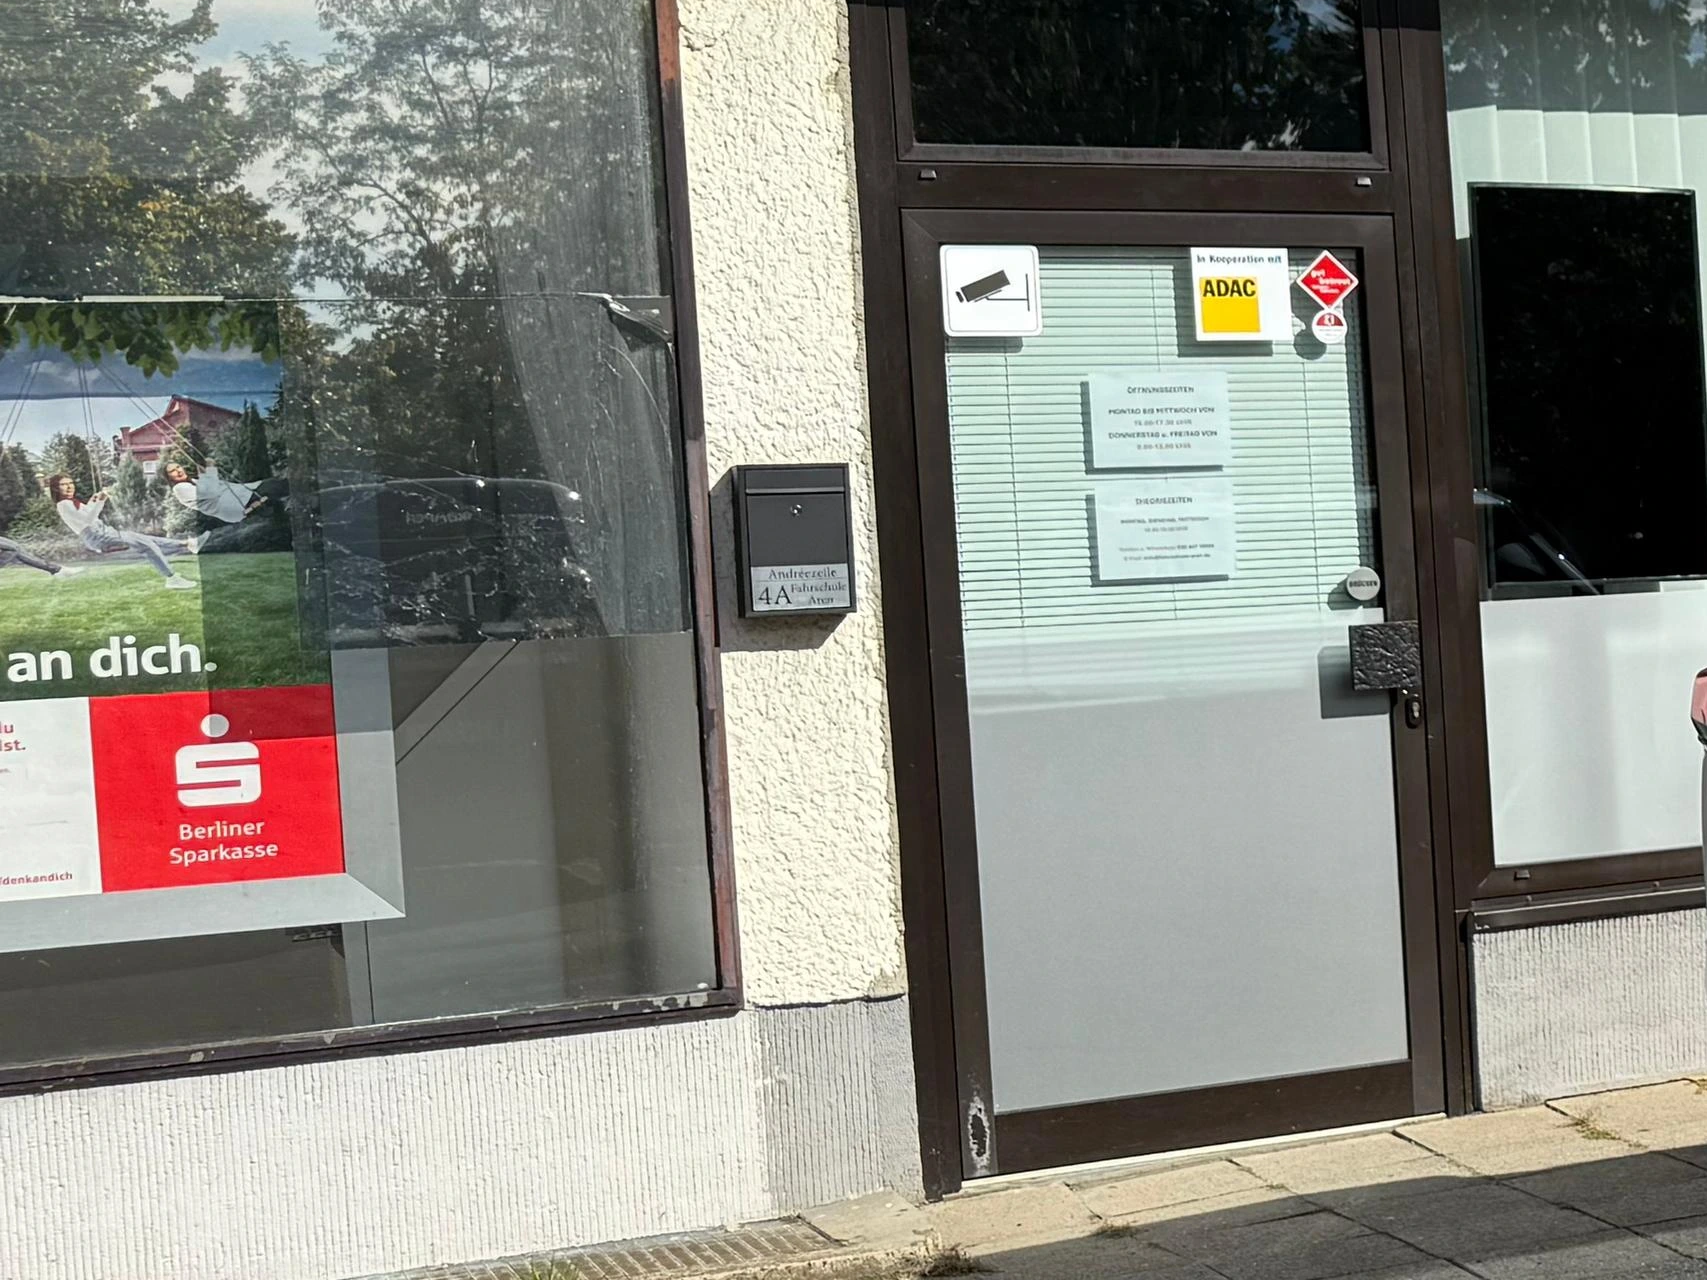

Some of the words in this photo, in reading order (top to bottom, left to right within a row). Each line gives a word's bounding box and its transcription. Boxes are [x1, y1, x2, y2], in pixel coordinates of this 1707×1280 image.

[1209, 254, 1265, 265] Kooperation
[1202, 278, 1257, 297] ADAC
[790, 581, 848, 594] Fahrschule
[807, 595, 835, 606] Aren
[7, 648, 73, 683] an
[89, 633, 218, 680] dich.
[0, 721, 14, 734] u
[179, 820, 266, 842] Berliner
[169, 842, 279, 867] Sparkasse
